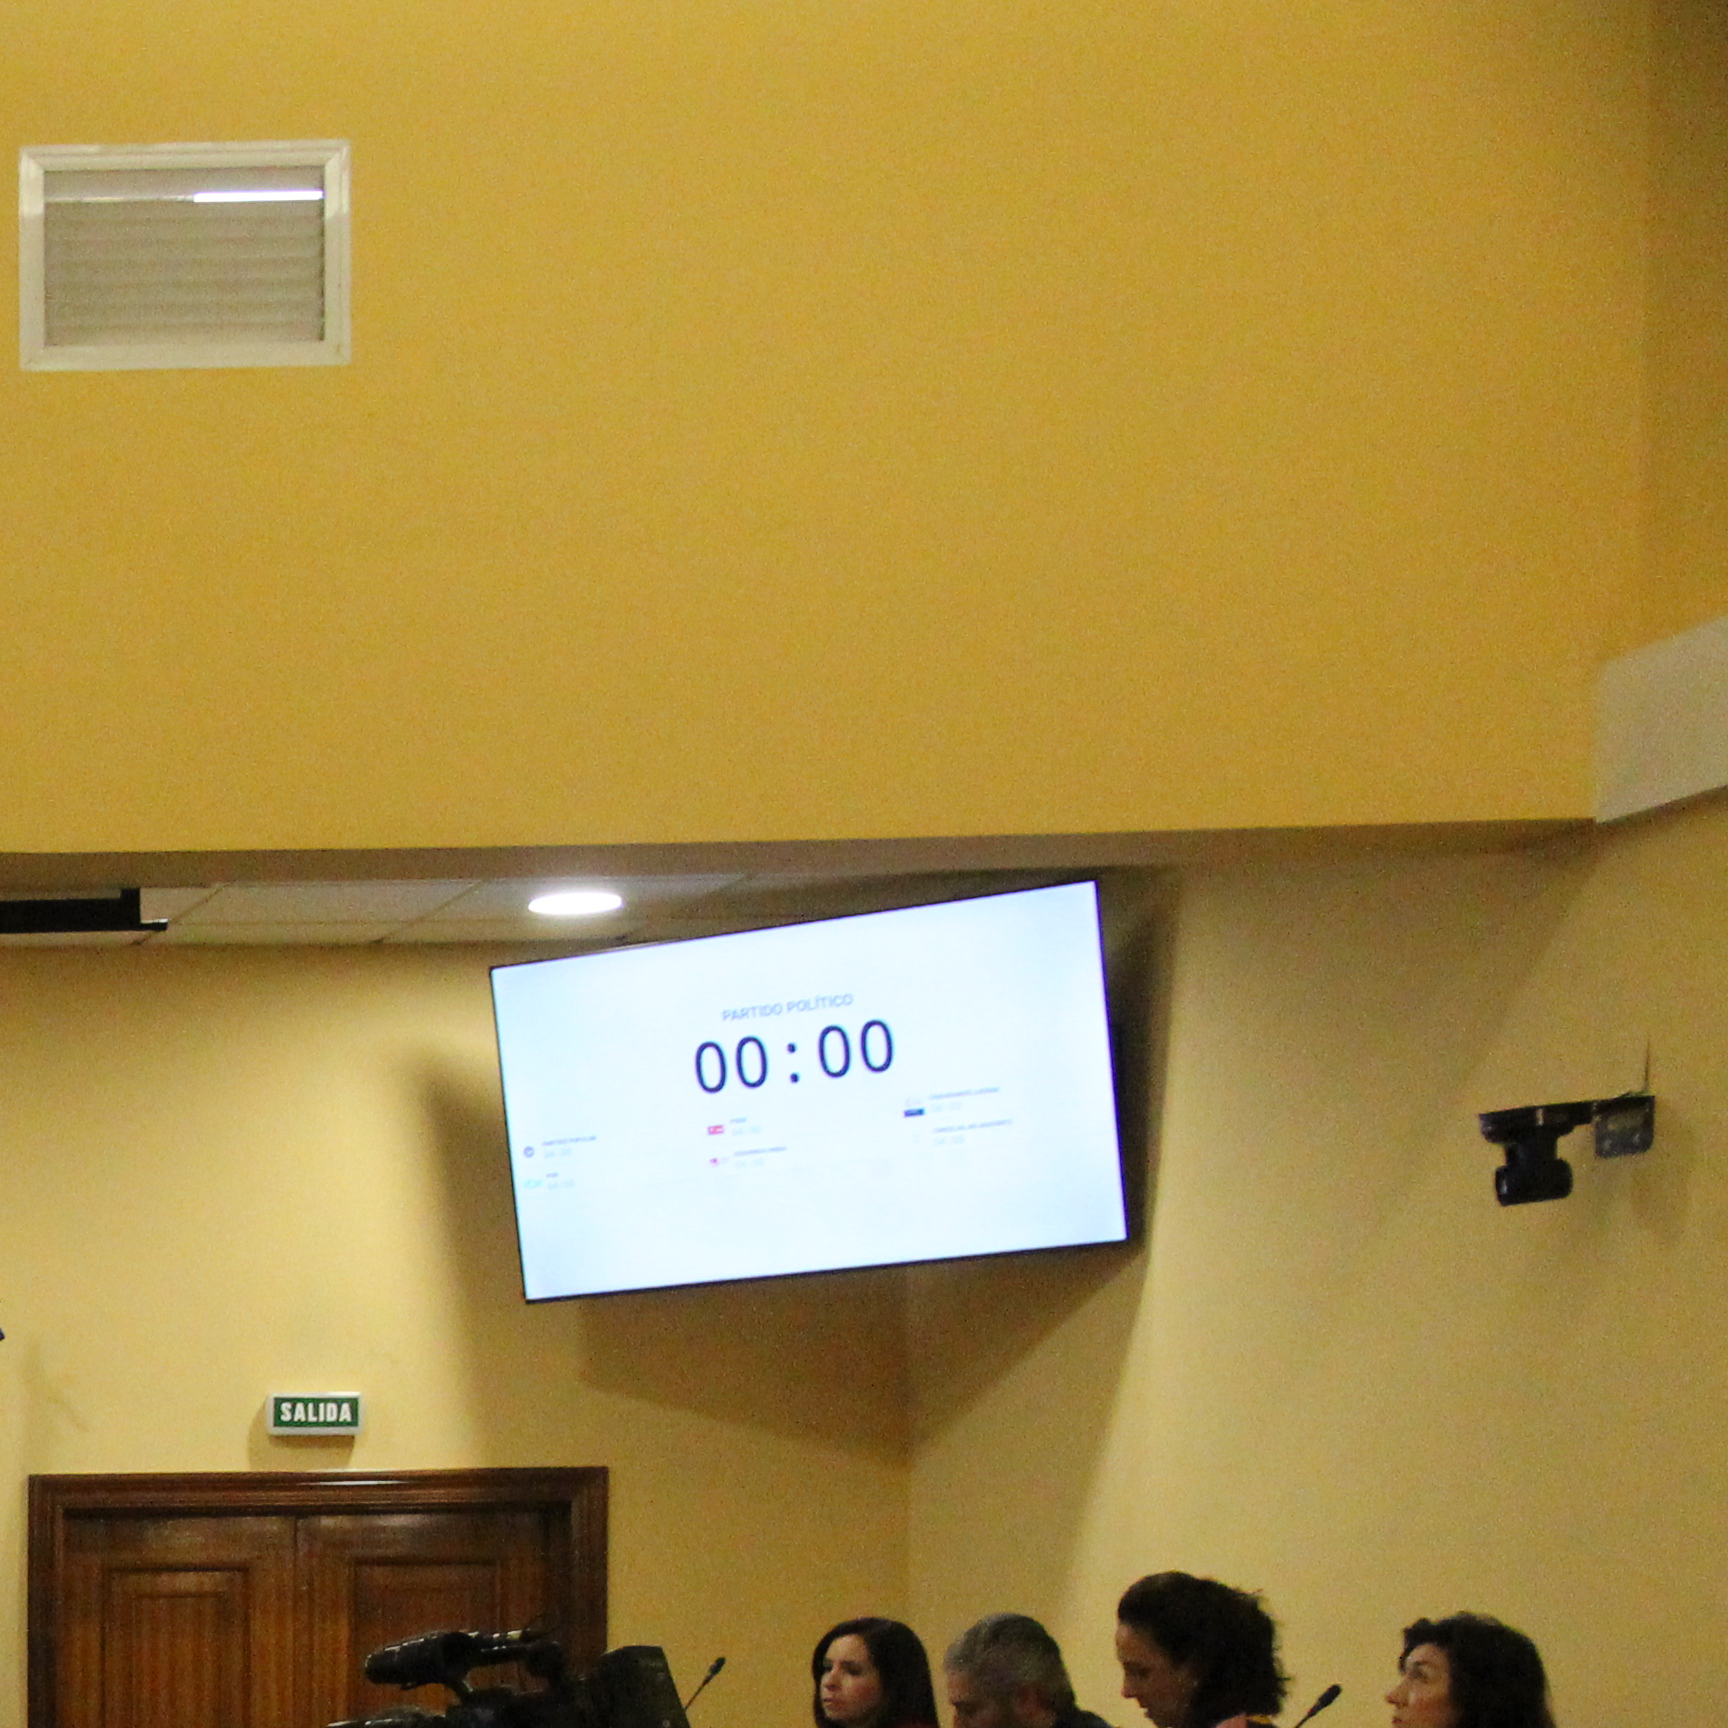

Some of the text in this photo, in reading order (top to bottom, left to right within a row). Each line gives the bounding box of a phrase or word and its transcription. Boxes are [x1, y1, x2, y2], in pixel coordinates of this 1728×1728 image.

[722, 993, 855, 1021] PARTIDO POLÍTICO
[695, 1019, 893, 1094] 00:00
[280, 1402, 352, 1422] SALIDA
